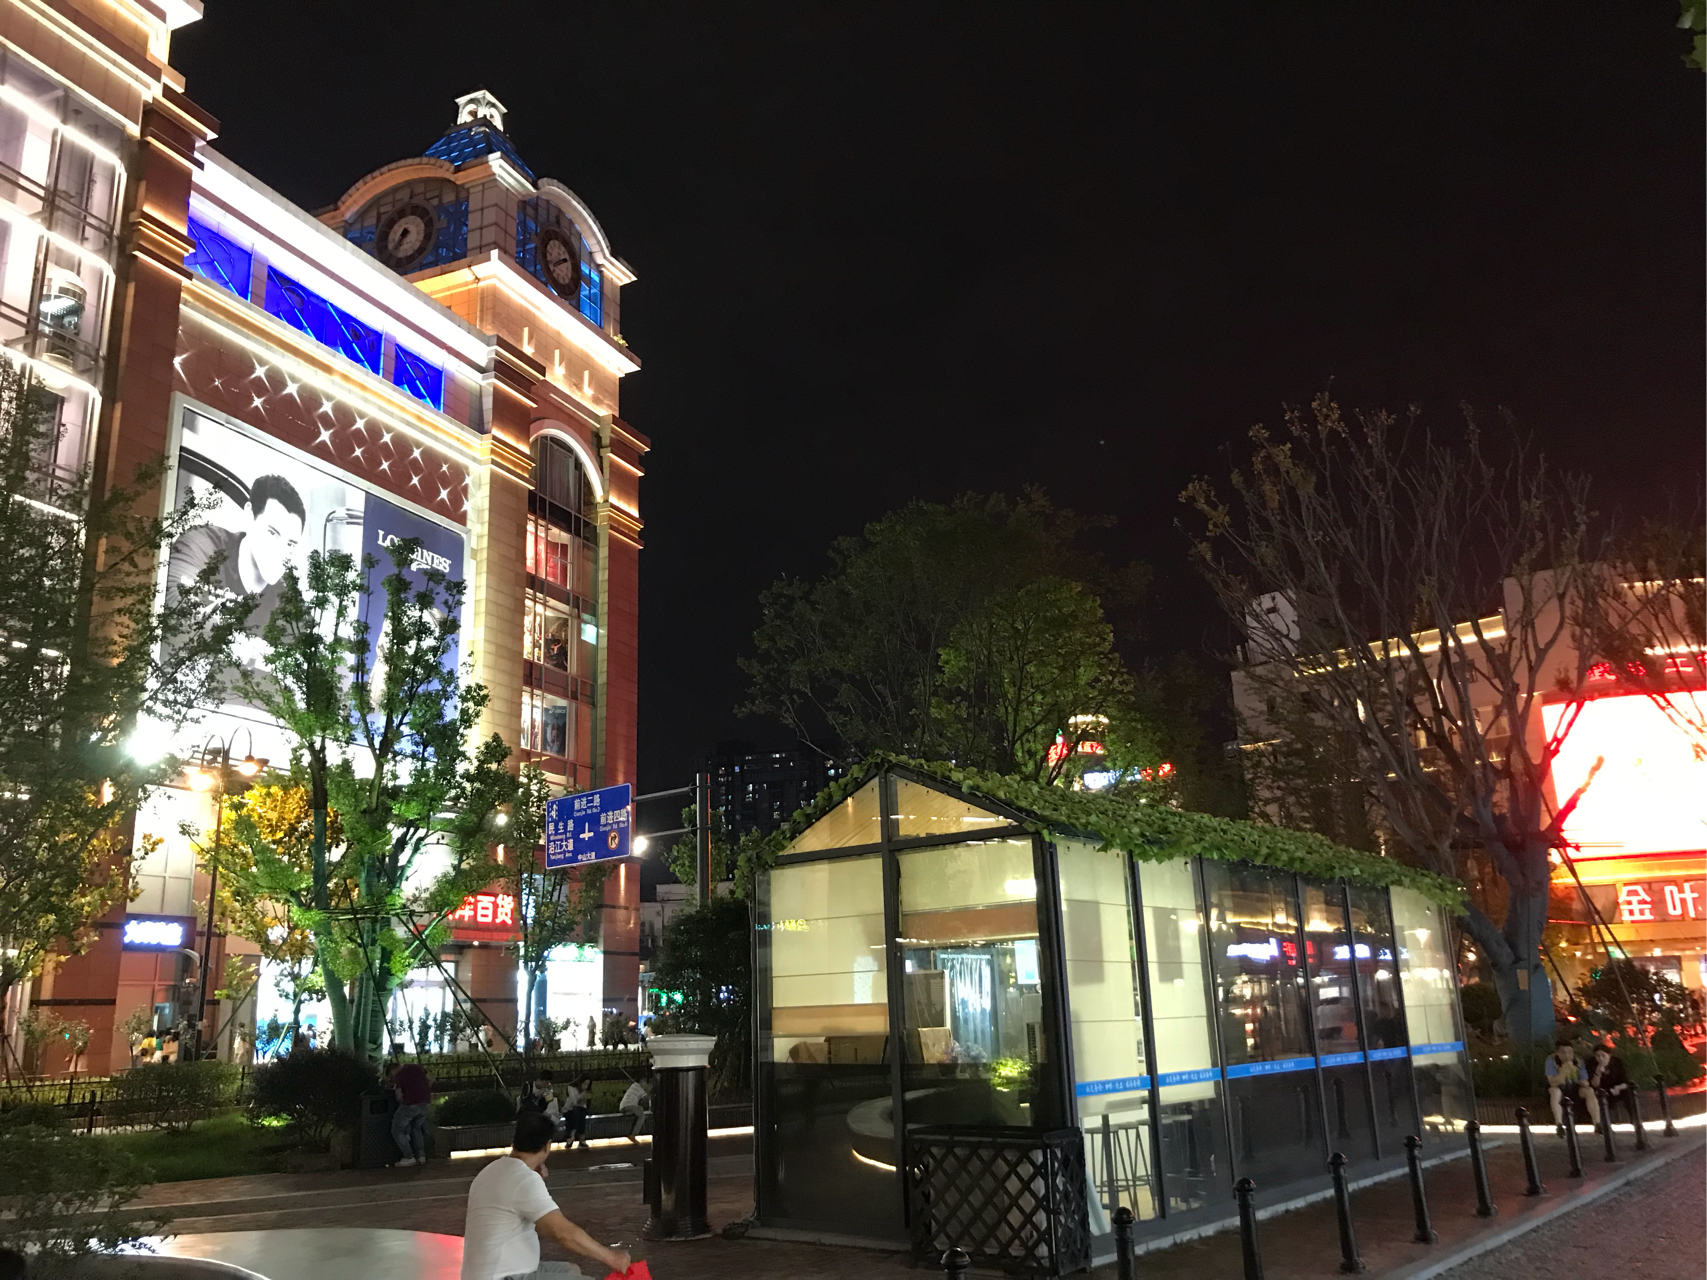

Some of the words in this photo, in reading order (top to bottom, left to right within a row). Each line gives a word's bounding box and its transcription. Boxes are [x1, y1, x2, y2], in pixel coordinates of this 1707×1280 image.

[377, 529, 452, 573] LOINES
[574, 794, 600, 810] 前进二路
[600, 808, 627, 825] 前进四路
[548, 819, 574, 835] 民生路
[548, 838, 574, 854] 沿江大道
[577, 852, 596, 861] 中山大道
[433, 893, 515, 926] 洋百货
[1617, 882, 1699, 921] 金叶
